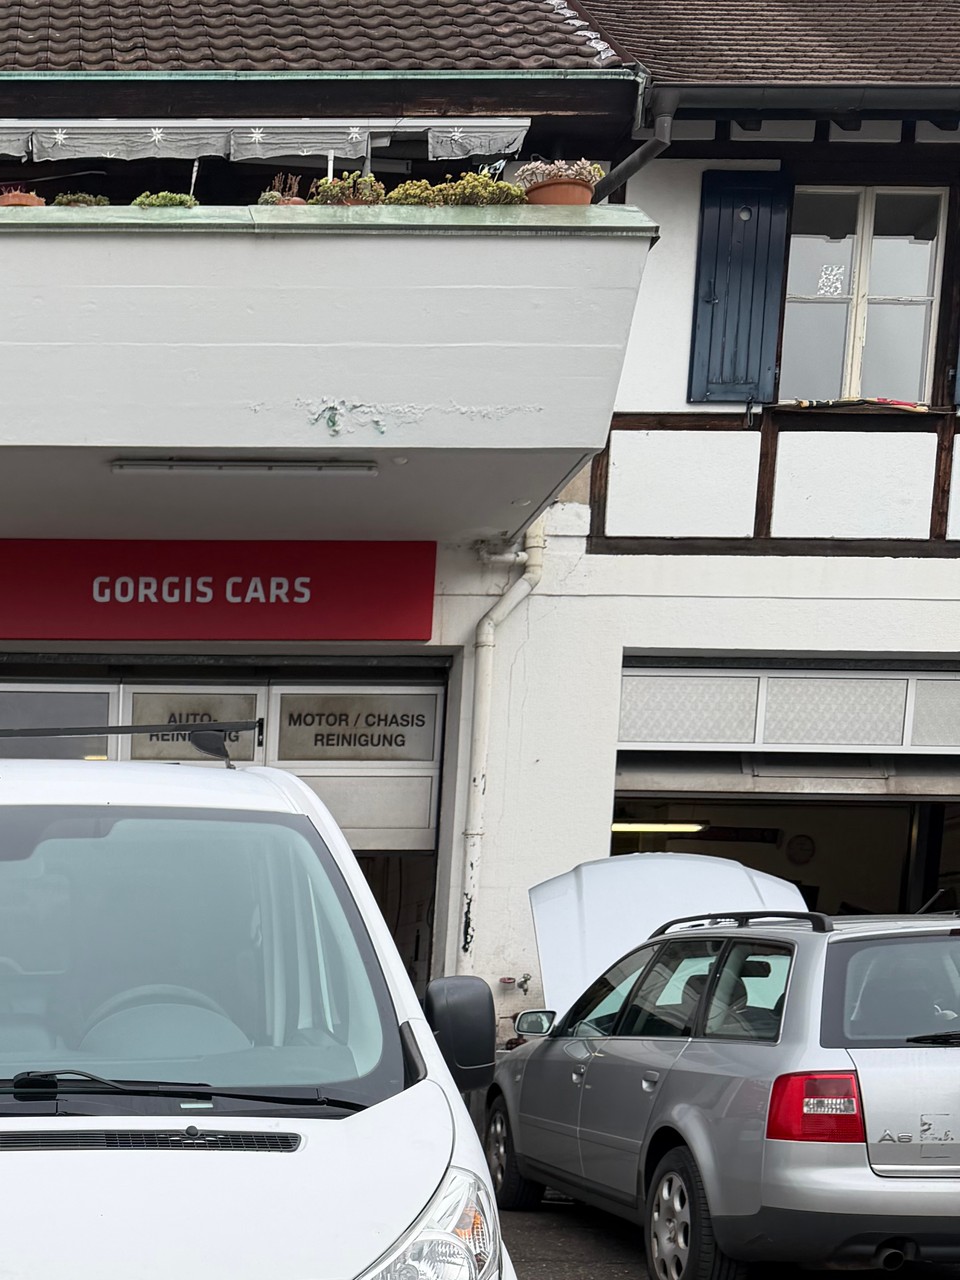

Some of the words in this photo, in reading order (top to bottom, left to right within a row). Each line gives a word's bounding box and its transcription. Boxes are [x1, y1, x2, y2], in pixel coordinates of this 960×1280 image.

[92, 575, 214, 604] GORGIS
[225, 575, 312, 604] CARS
[288, 713, 349, 727] MOTOR
[353, 713, 361, 727] /
[364, 713, 426, 727] CHASIS
[314, 733, 406, 747] REINIGUNG
[878, 1129, 913, 1143] A6
